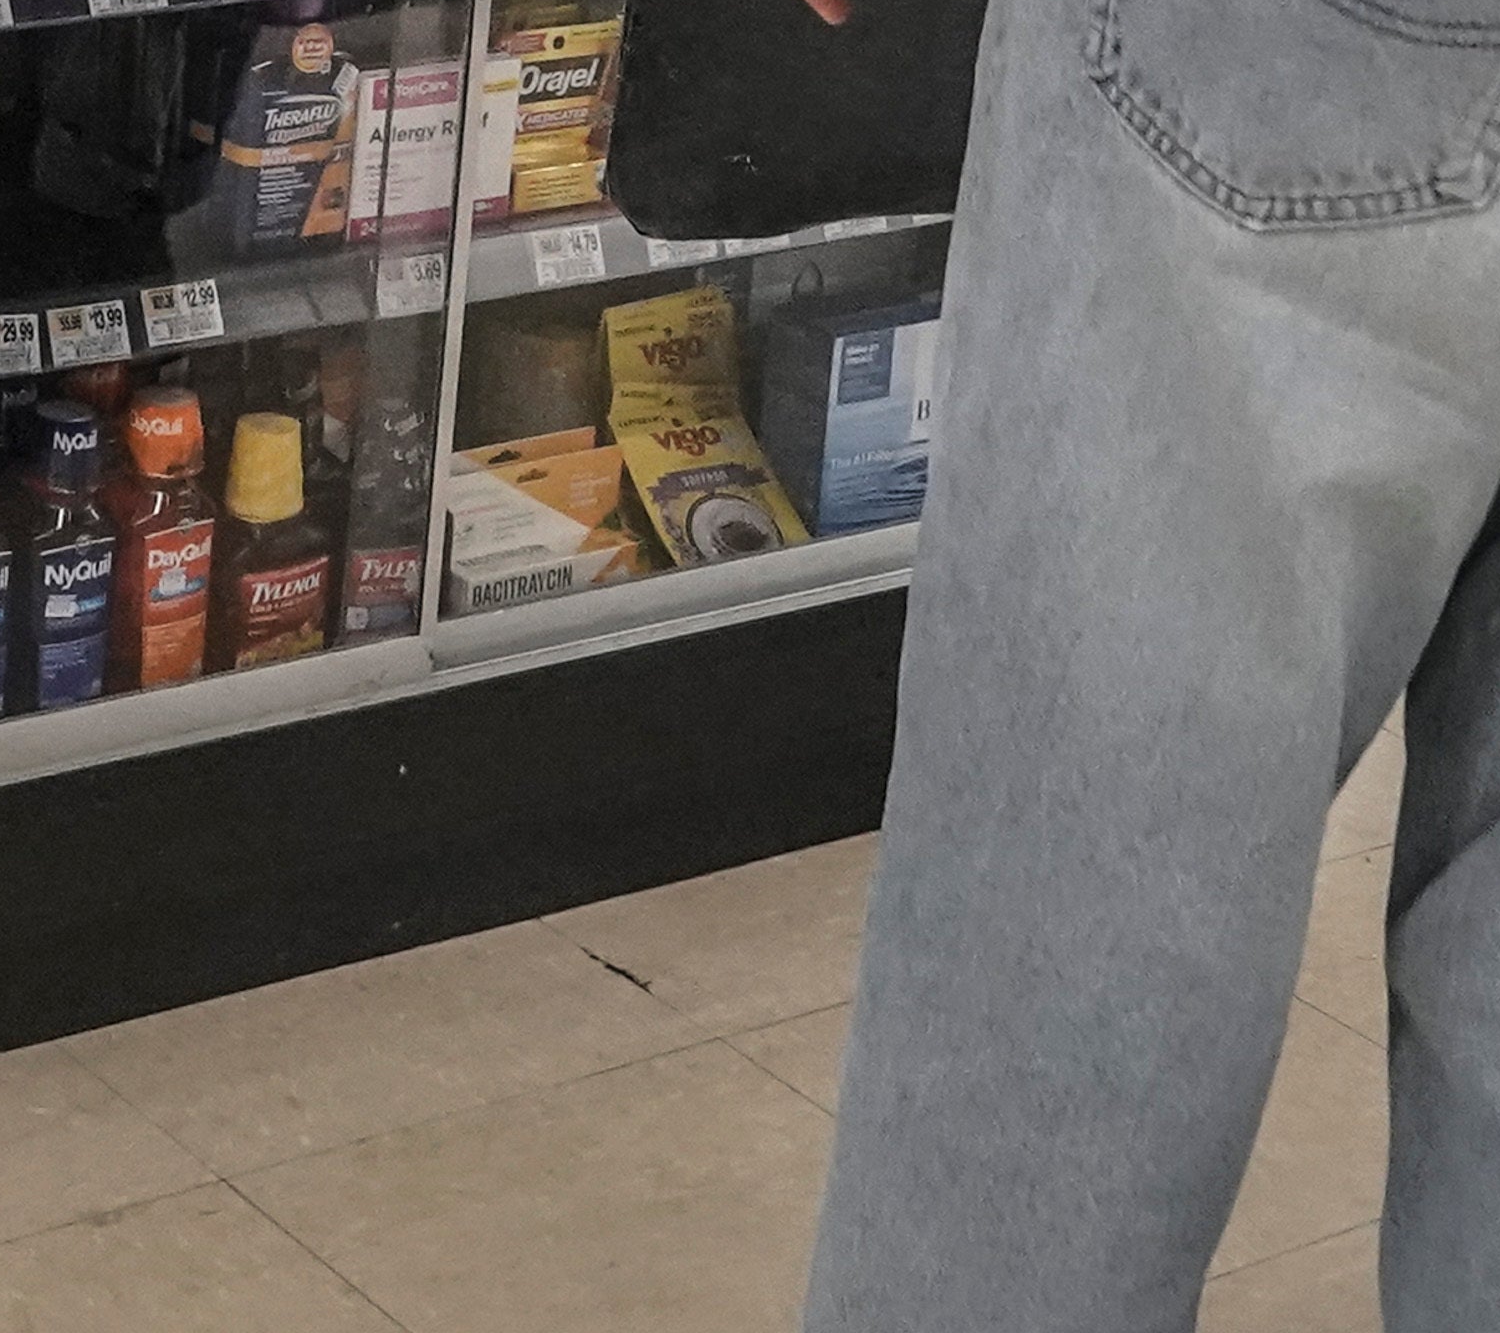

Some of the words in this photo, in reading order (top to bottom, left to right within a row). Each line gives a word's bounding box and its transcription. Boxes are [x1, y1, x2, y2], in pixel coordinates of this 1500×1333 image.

[520, 59, 597, 96] Orajel
[264, 102, 338, 132] THERAFLU
[148, 533, 213, 570] DayQuil
[44, 551, 112, 590] NyQuil
[251, 571, 320, 605] TYLENOL
